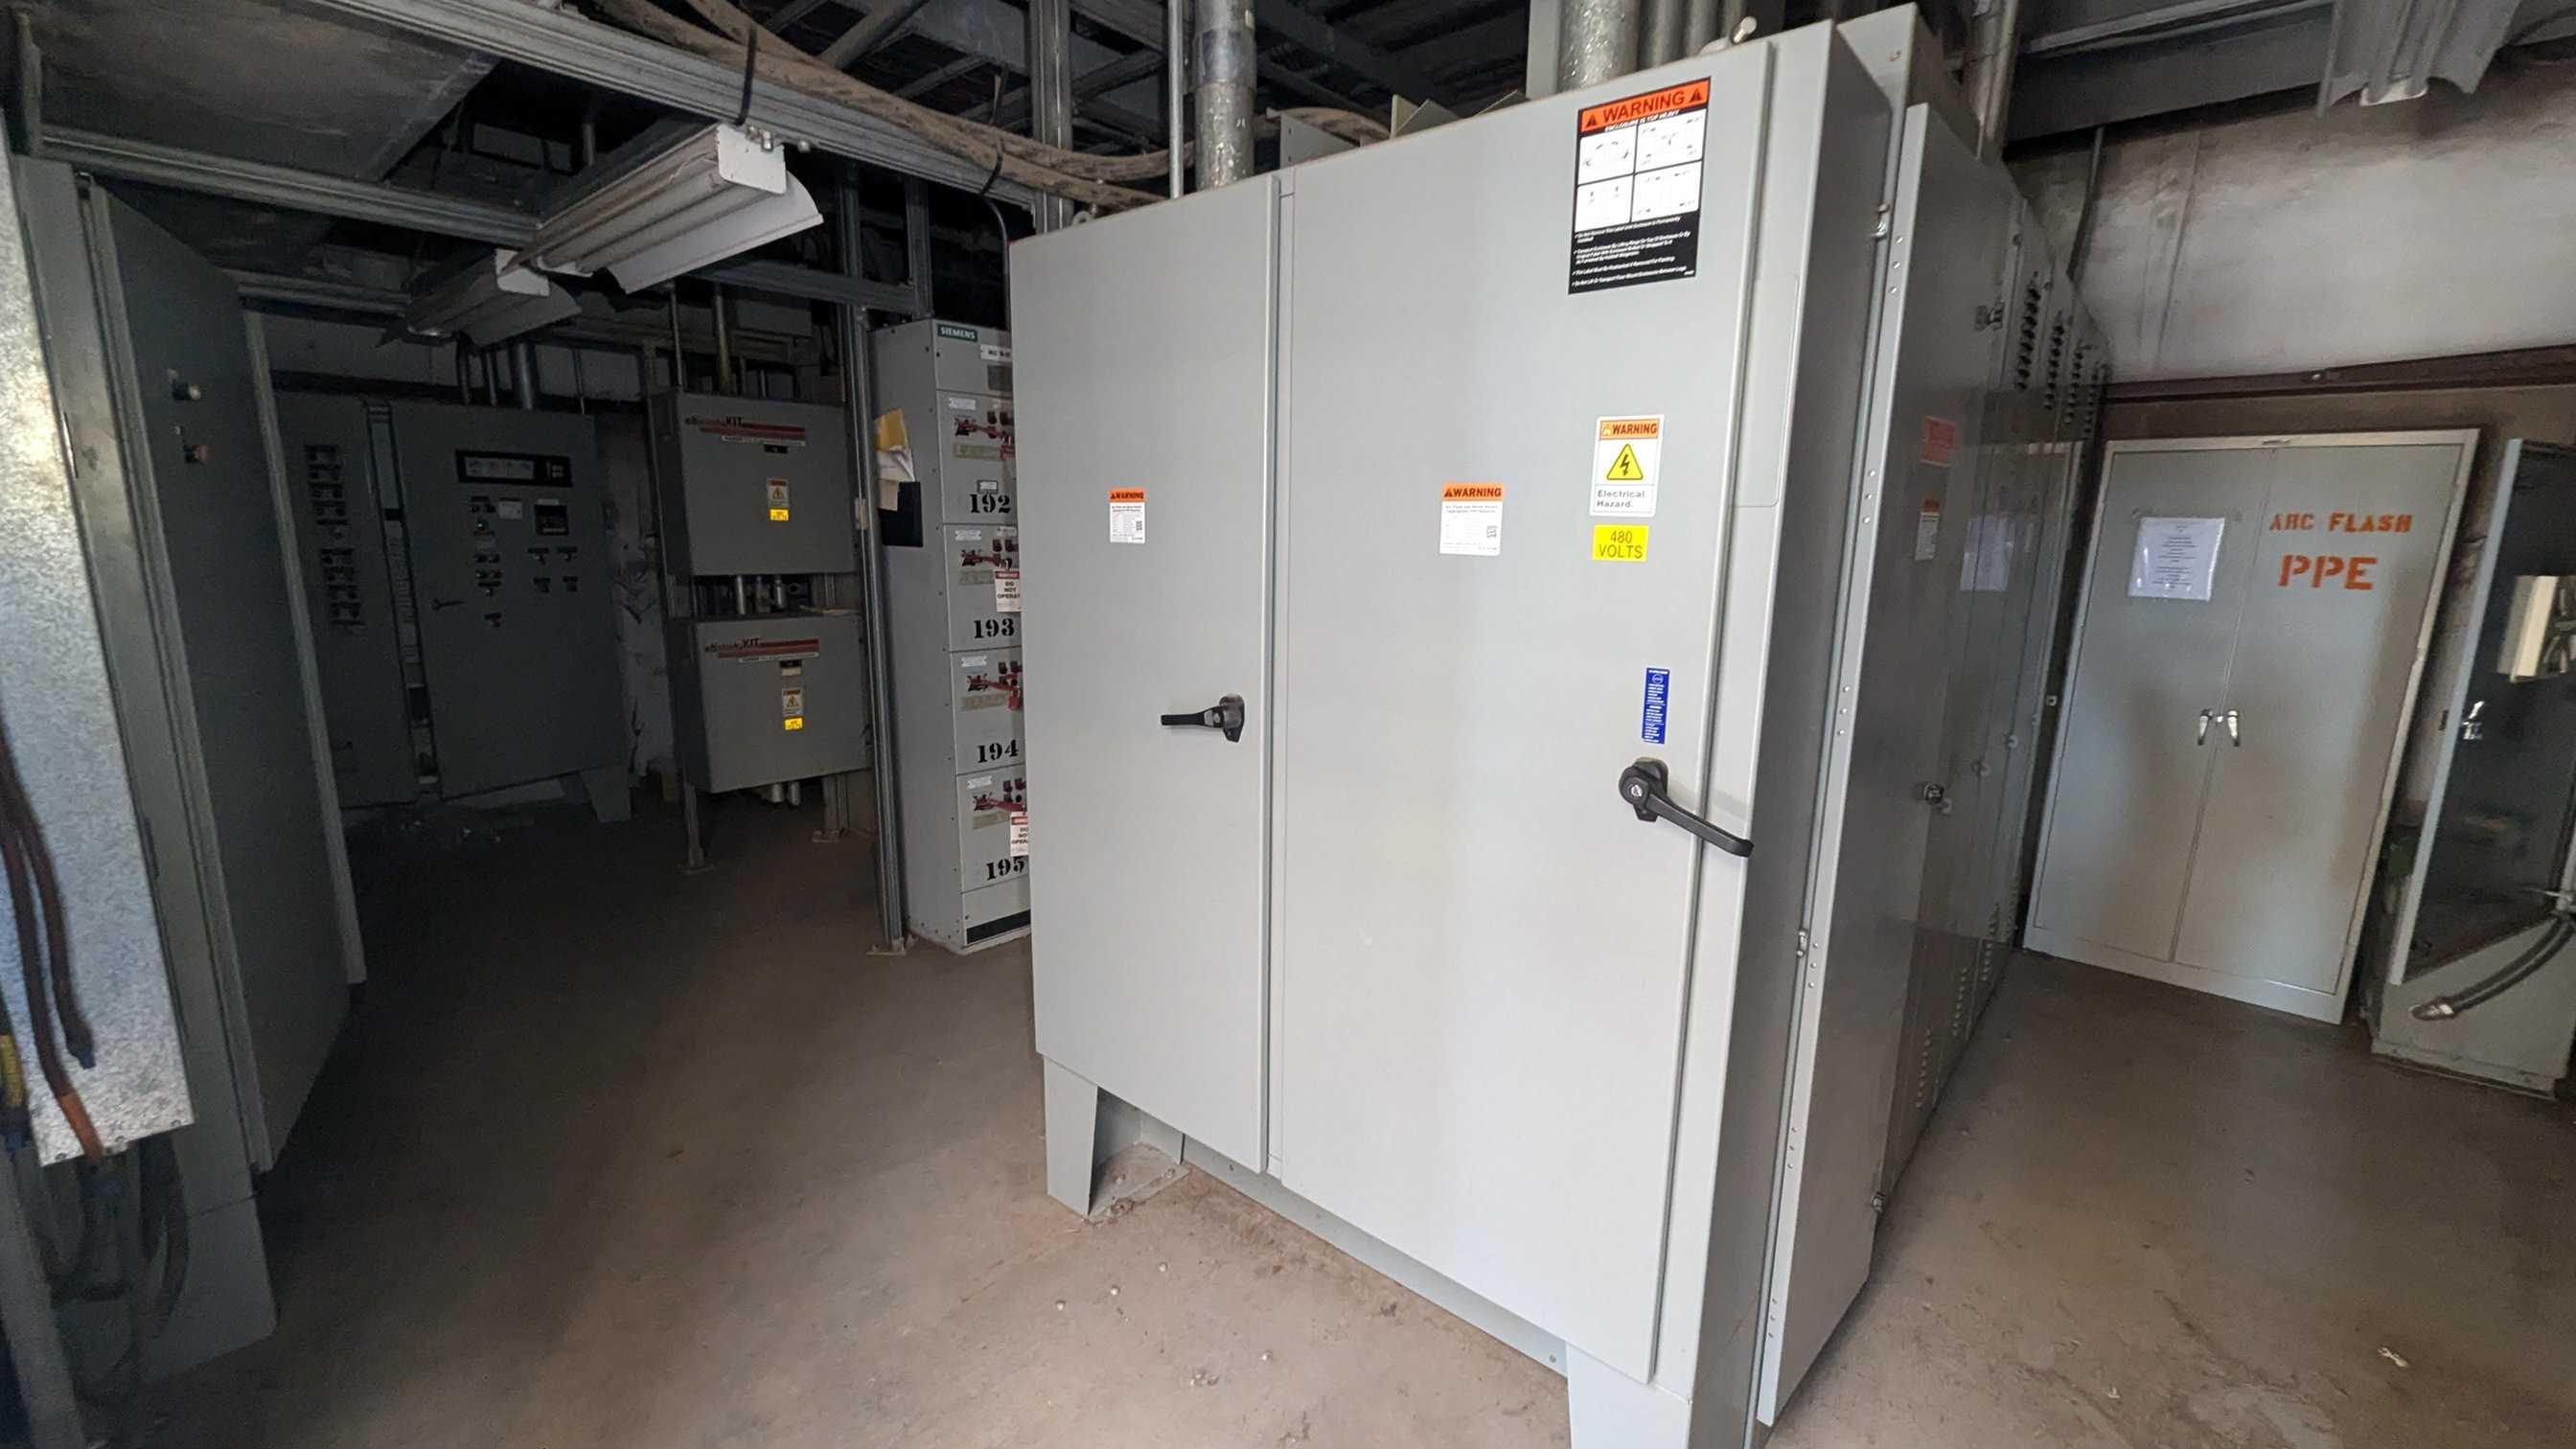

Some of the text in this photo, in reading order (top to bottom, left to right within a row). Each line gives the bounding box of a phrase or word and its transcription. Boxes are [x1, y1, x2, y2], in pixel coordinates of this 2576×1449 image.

[1603, 91, 1685, 123] WARNING
[940, 327, 976, 339] SIEMENS
[1612, 423, 1657, 435] WARNING
[1453, 488, 1502, 497] WARNING
[1597, 490, 1644, 498] Electrical
[970, 494, 1011, 514] 192
[2269, 513, 2412, 533] ARC FLASH
[1611, 530, 1633, 543] 480
[1598, 544, 1644, 559] VOLTS
[2278, 555, 2378, 590] PPE
[974, 618, 1015, 638] 193
[978, 740, 1019, 763] 194
[986, 856, 1024, 881] 195
